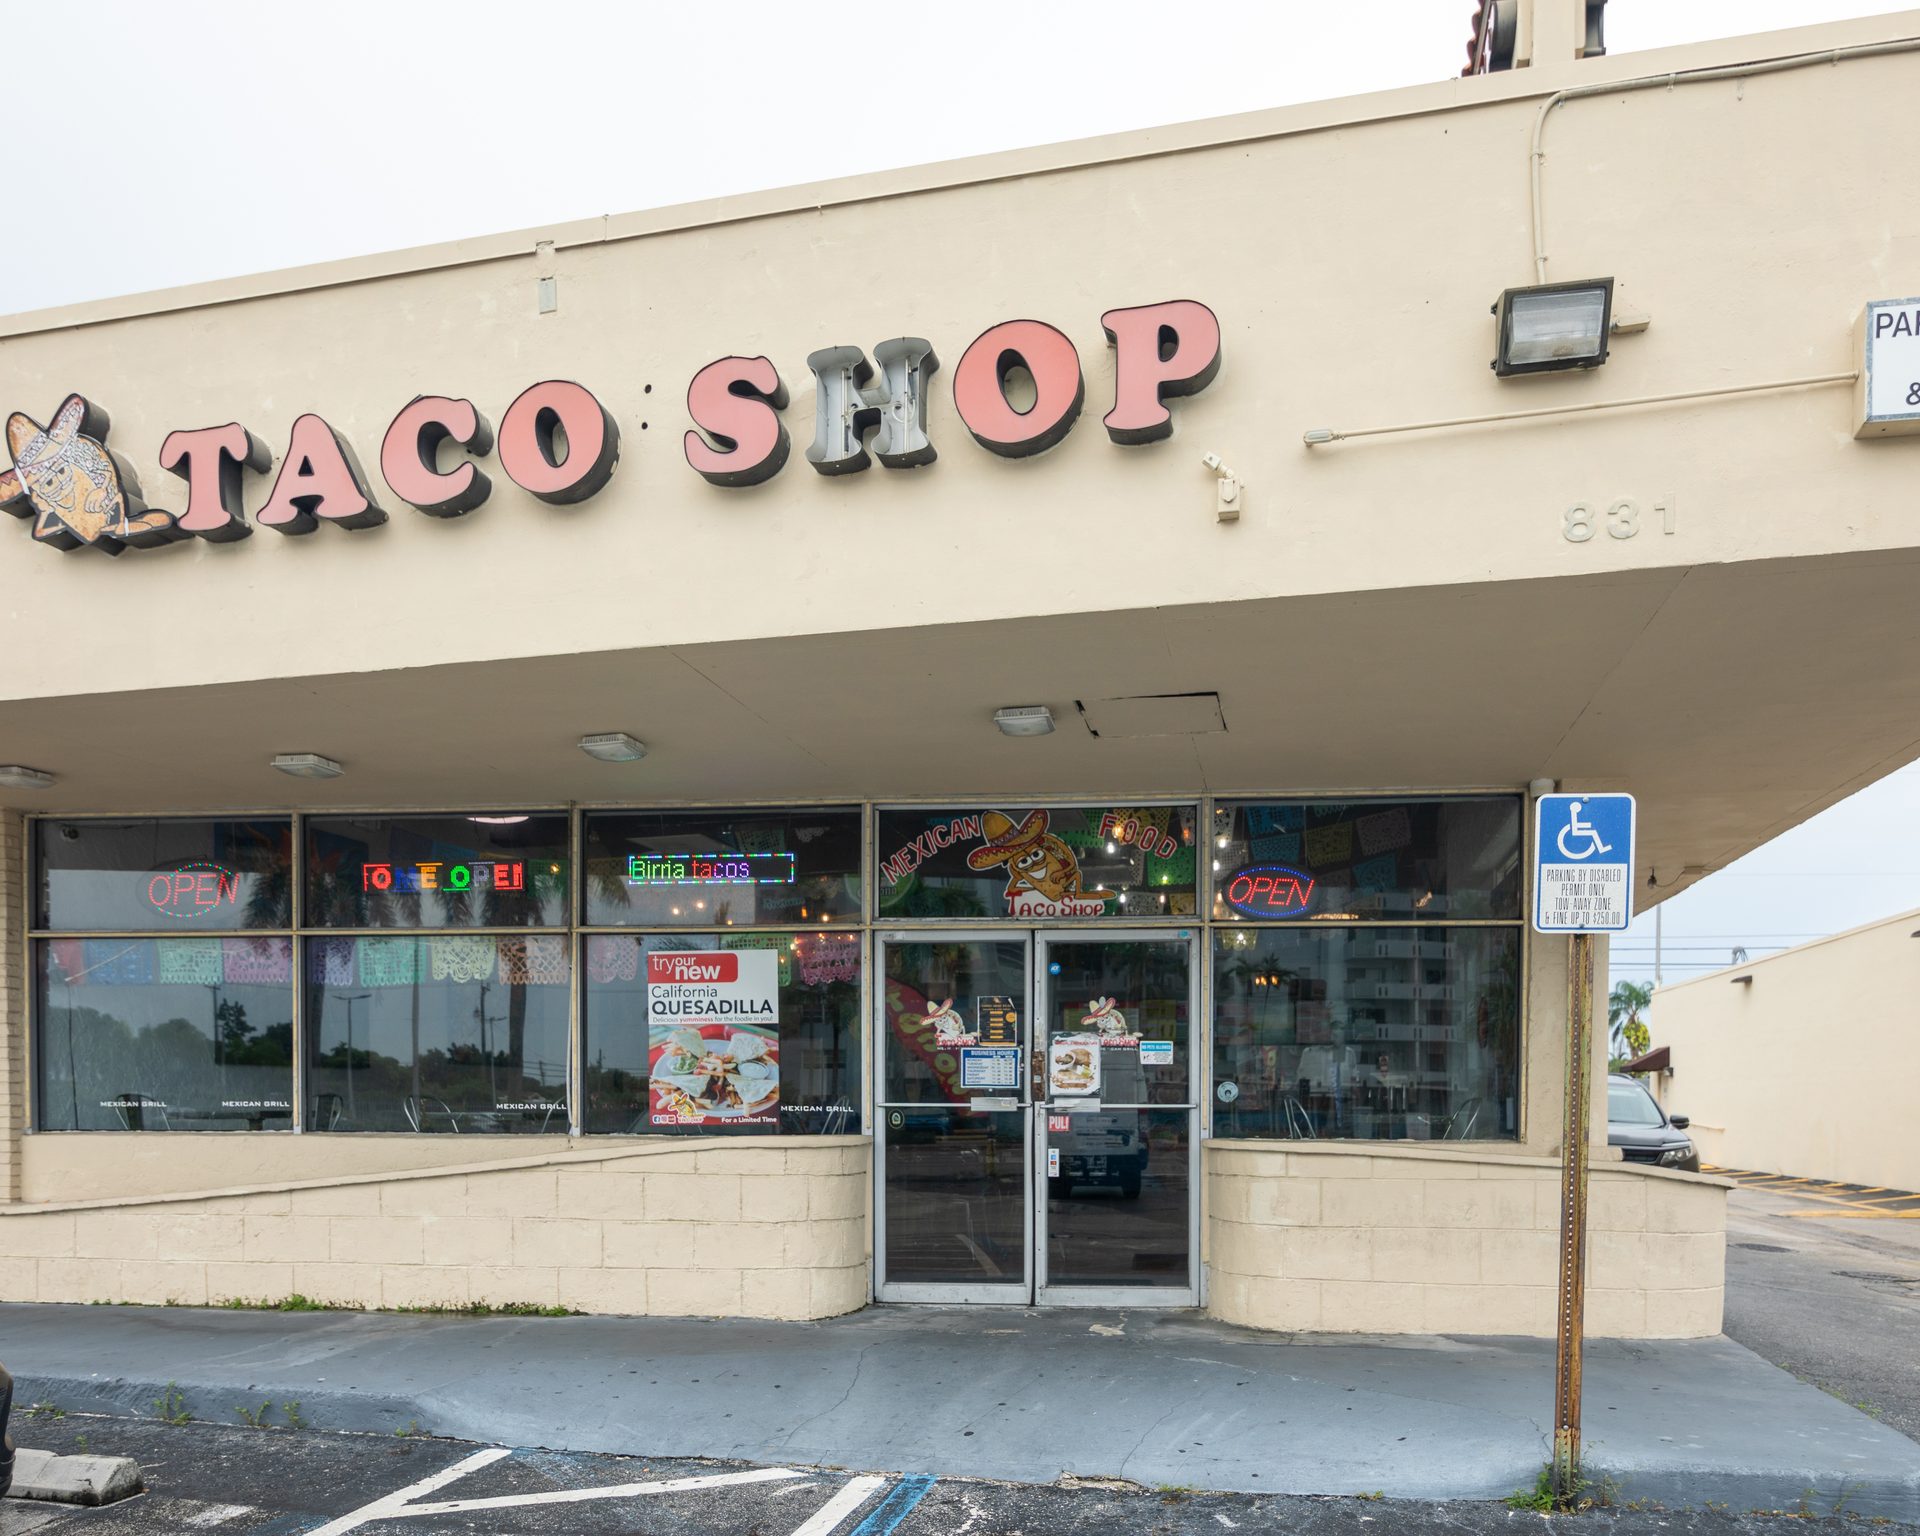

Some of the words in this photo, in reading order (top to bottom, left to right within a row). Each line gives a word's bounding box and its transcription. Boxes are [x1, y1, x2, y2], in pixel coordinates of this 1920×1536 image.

[159, 379, 618, 540] TACO
[684, 299, 1221, 486] SHOP
[1562, 493, 1676, 543] 831
[880, 814, 982, 886] MEXICAN
[1098, 813, 1178, 859] FOOD
[632, 860, 685, 880] Birria
[692, 860, 749, 879] tacos
[1546, 869, 1576, 882] PARKING
[1578, 869, 1586, 882] BY
[1589, 869, 1621, 882] DISABLED
[148, 873, 240, 907] OPEN
[1229, 875, 1315, 907] OPEN
[1561, 884, 1586, 896] PERMIT
[1588, 884, 1606, 896] ONLY
[1004, 890, 1056, 916] TACO
[1060, 895, 1105, 916] SHOP
[1555, 897, 1592, 910] TOW-AWAY
[1594, 897, 1611, 910] ZONE
[1545, 912, 1550, 924] &
[1553, 912, 1568, 924] FINE
[1571, 912, 1579, 924] UP
[1582, 912, 1590, 924] TO
[1593, 912, 1621, 925] $250.00
[652, 955, 676, 975] try
[675, 957, 696, 966] our
[675, 965, 721, 981] new
[651, 985, 718, 999] California
[652, 999, 774, 1015] QUESADILLA
